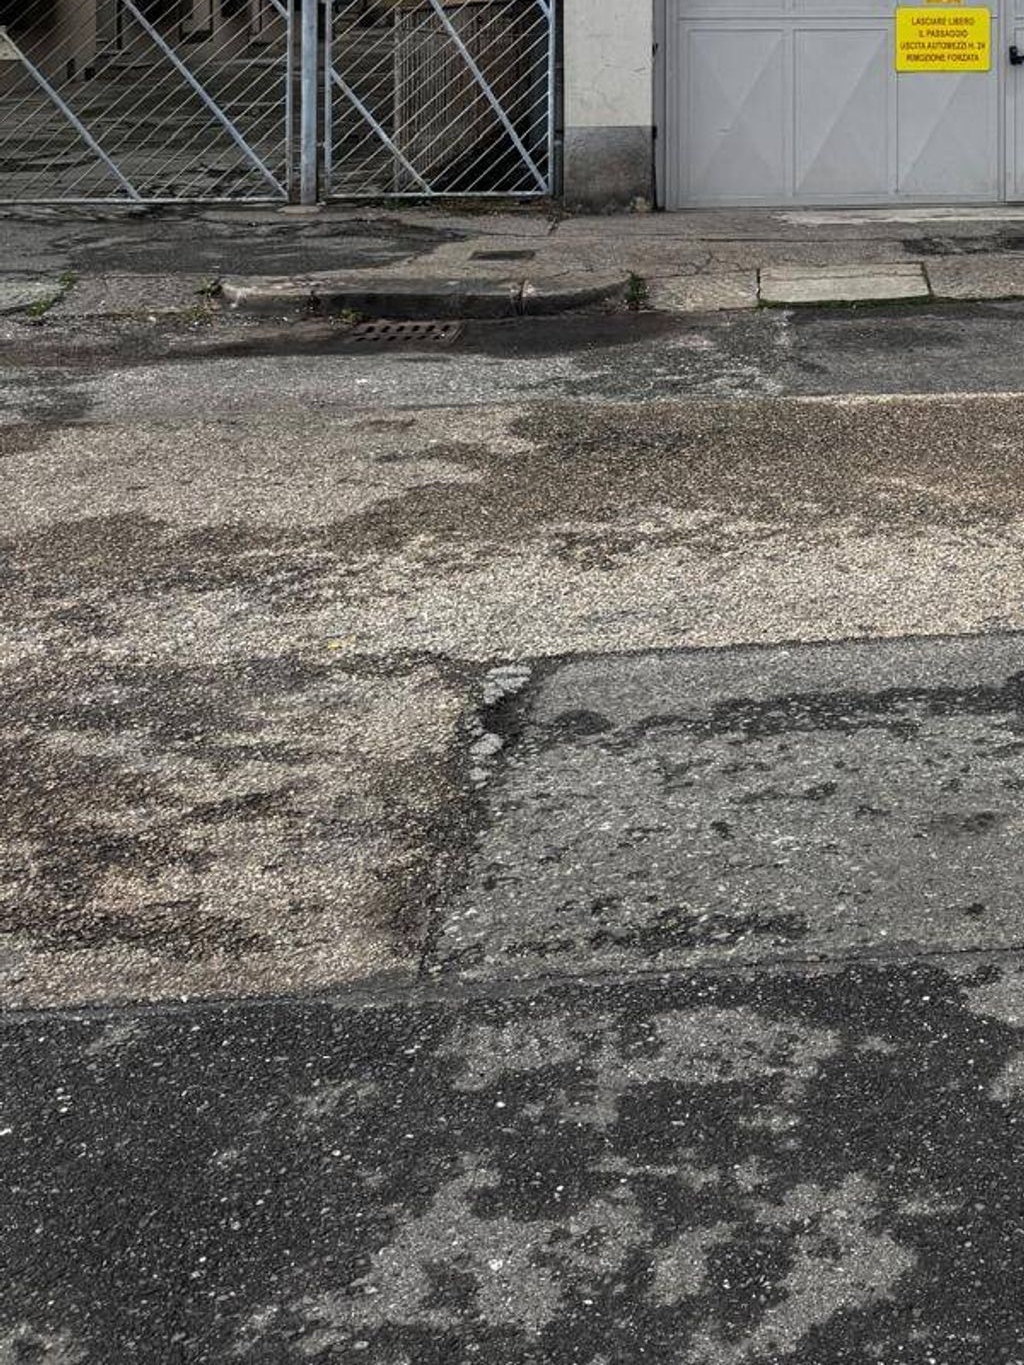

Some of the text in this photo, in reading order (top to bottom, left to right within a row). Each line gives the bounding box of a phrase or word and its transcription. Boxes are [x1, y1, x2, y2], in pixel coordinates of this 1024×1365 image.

[911, 17, 976, 26] LASCIARE LIBERO
[927, 29, 969, 38] PASSAGGIO
[900, 41, 925, 50] USCITA
[906, 53, 980, 62] RIMOZIONE FORZATA
